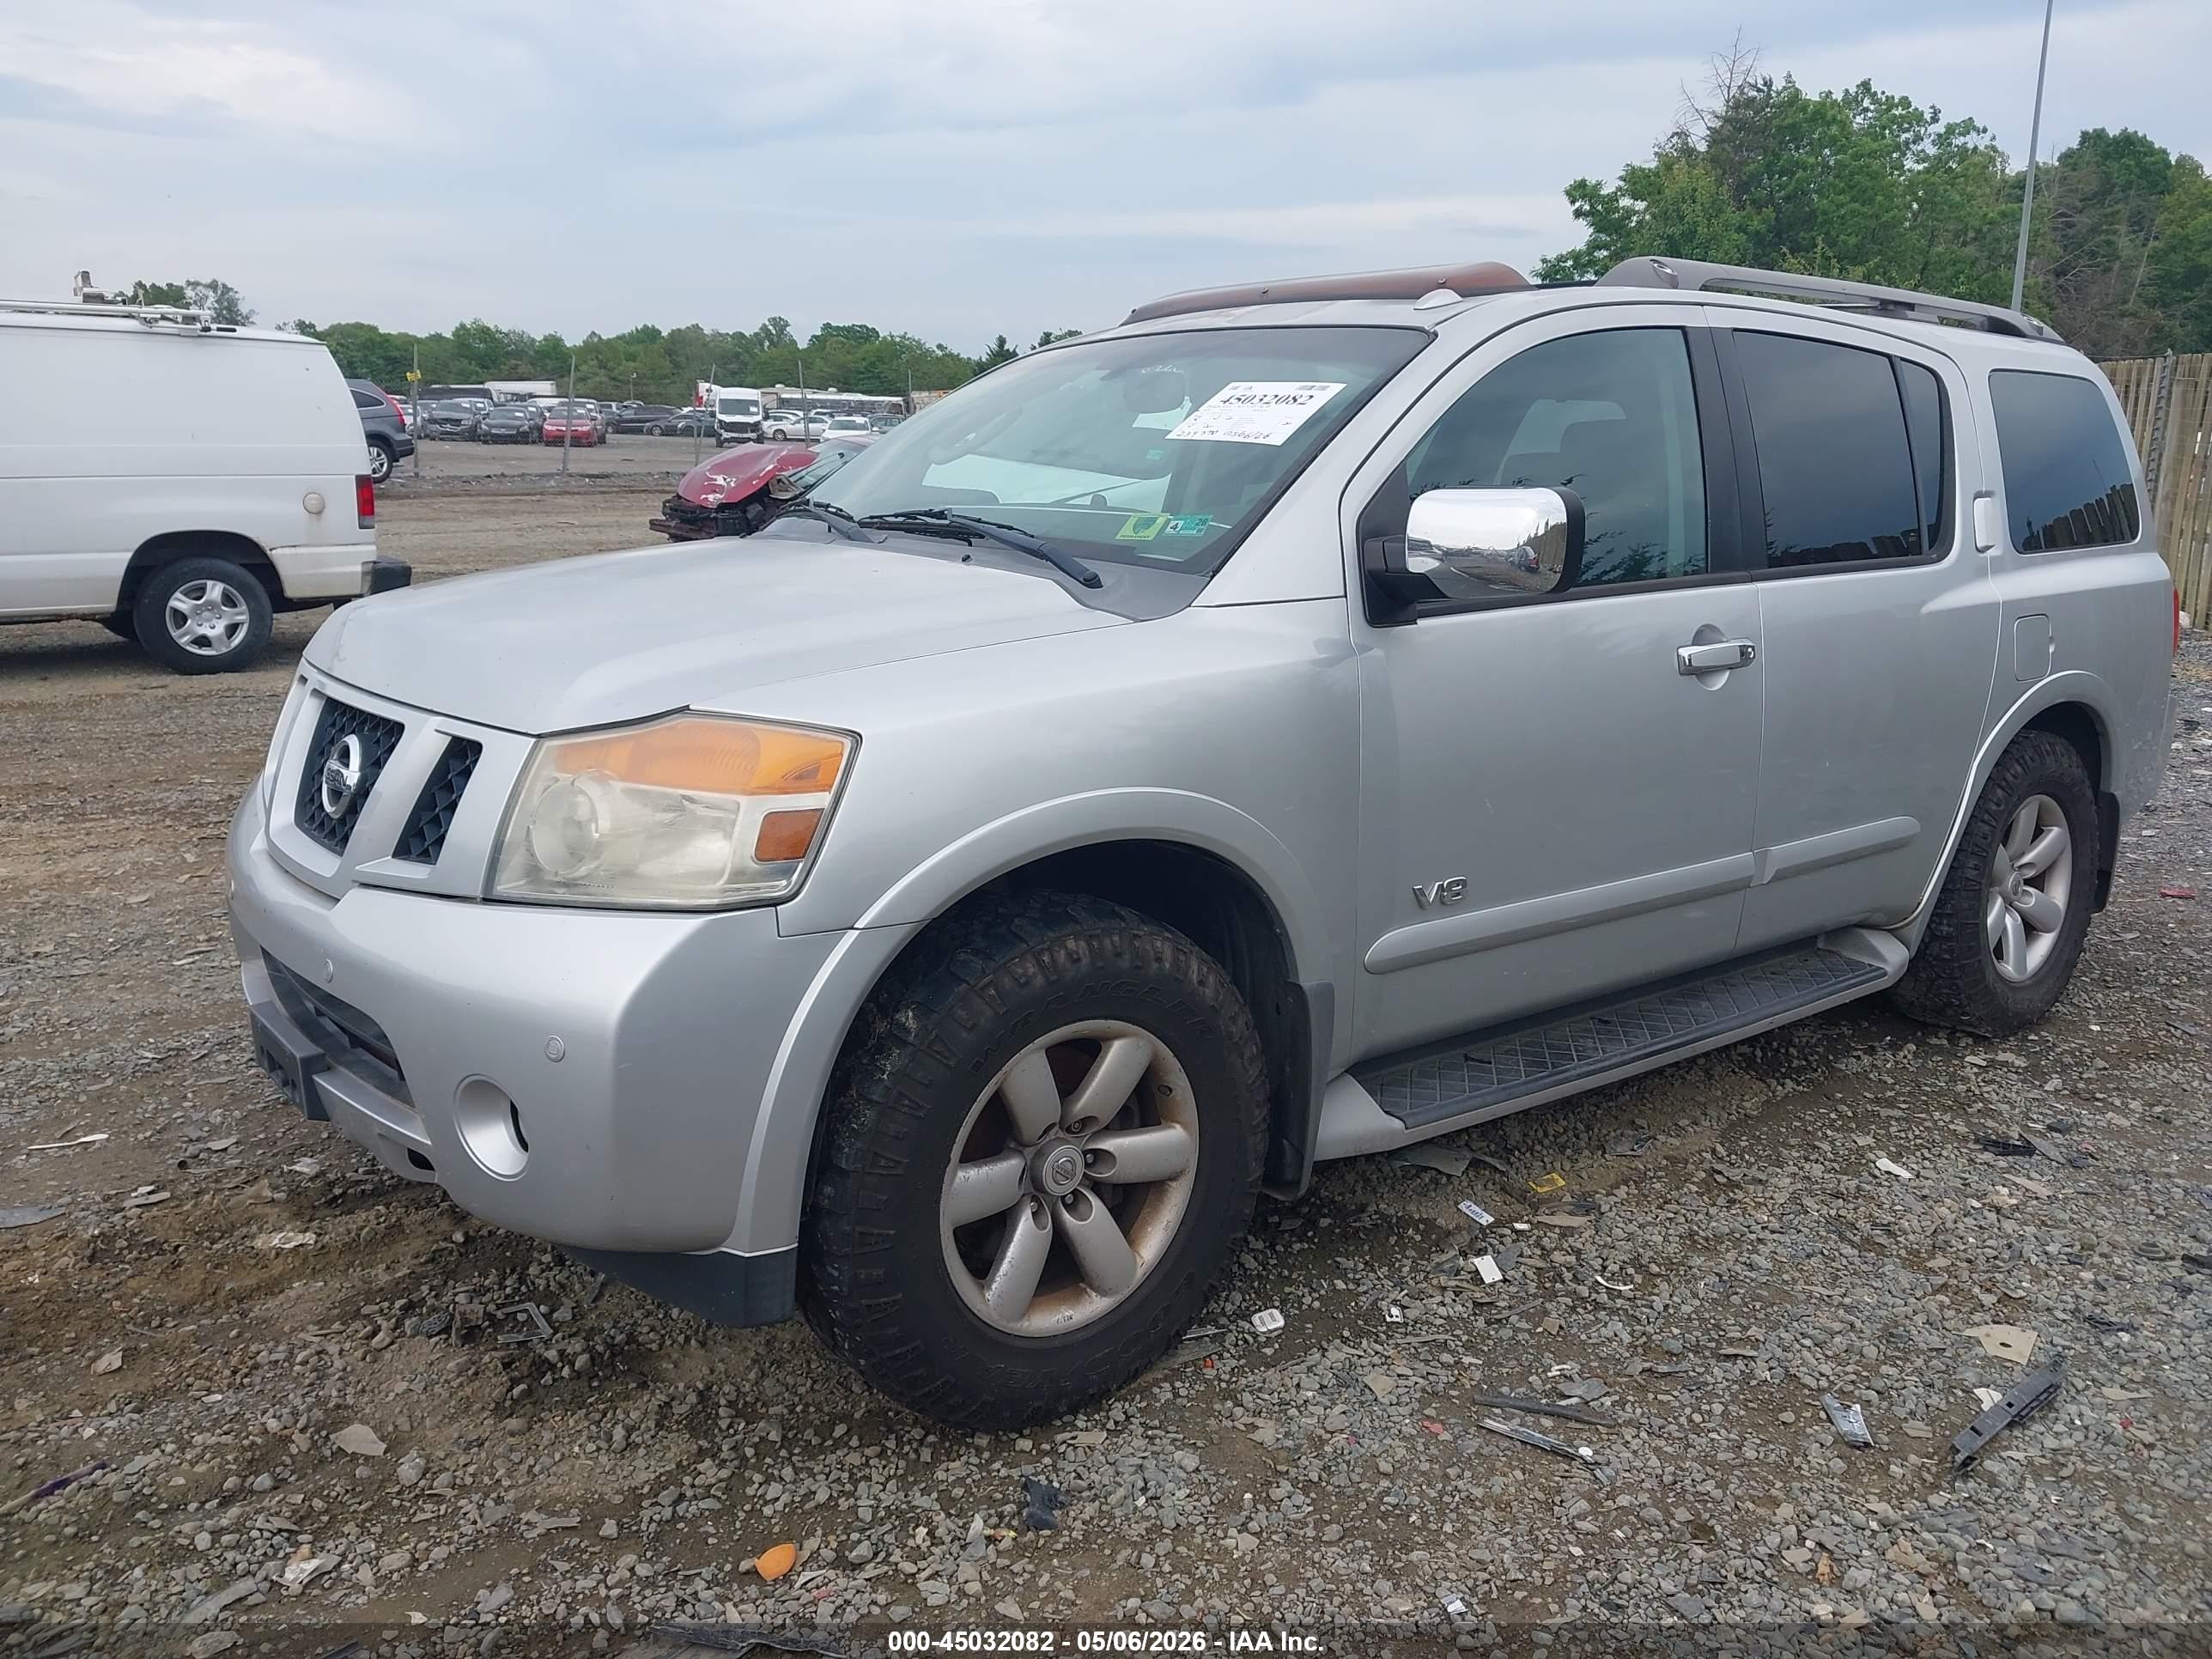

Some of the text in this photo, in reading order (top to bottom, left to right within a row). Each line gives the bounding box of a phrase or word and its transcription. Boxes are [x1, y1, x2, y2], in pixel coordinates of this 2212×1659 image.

[1219, 393, 1315, 406] 45032082
[1170, 522, 1179, 532] 4
[1412, 876, 1468, 910] V8
